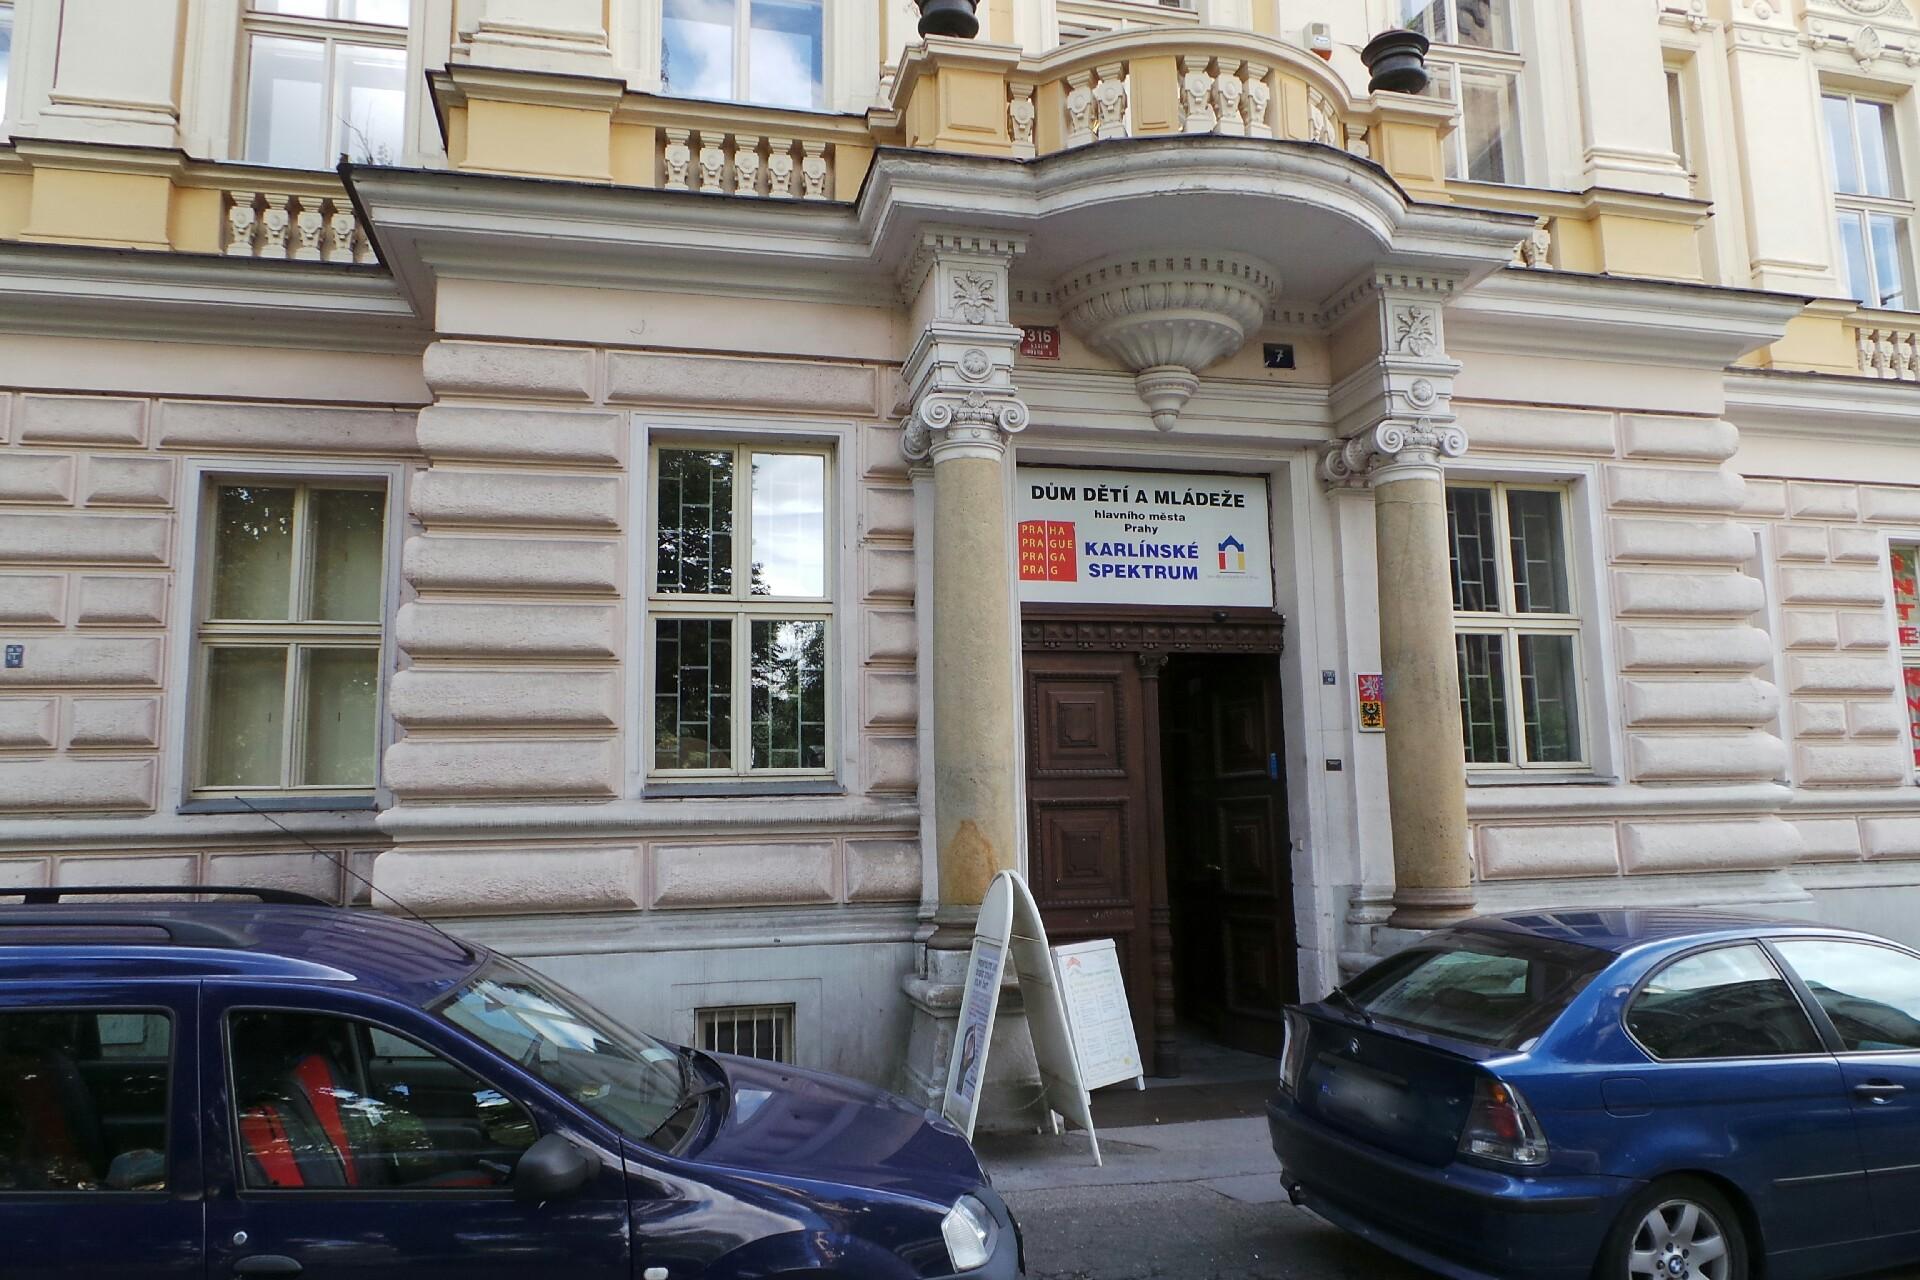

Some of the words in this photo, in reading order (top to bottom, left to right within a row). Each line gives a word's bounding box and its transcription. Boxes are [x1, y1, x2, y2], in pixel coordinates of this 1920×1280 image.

[1027, 329, 1052, 343] 316
[1274, 349, 1284, 363] 7
[1031, 482, 1076, 501] DŮM
[1083, 484, 1129, 503] DĚTÍ
[1135, 489, 1148, 504] A
[1154, 488, 1245, 508] MLÁDEŽE
[1094, 509, 1145, 520] hlavního
[1149, 512, 1186, 522] města
[1124, 523, 1158, 535] Prahy
[1085, 540, 1199, 559] KARLÍNSKÉ
[1088, 563, 1198, 580] SPEKTRUM
